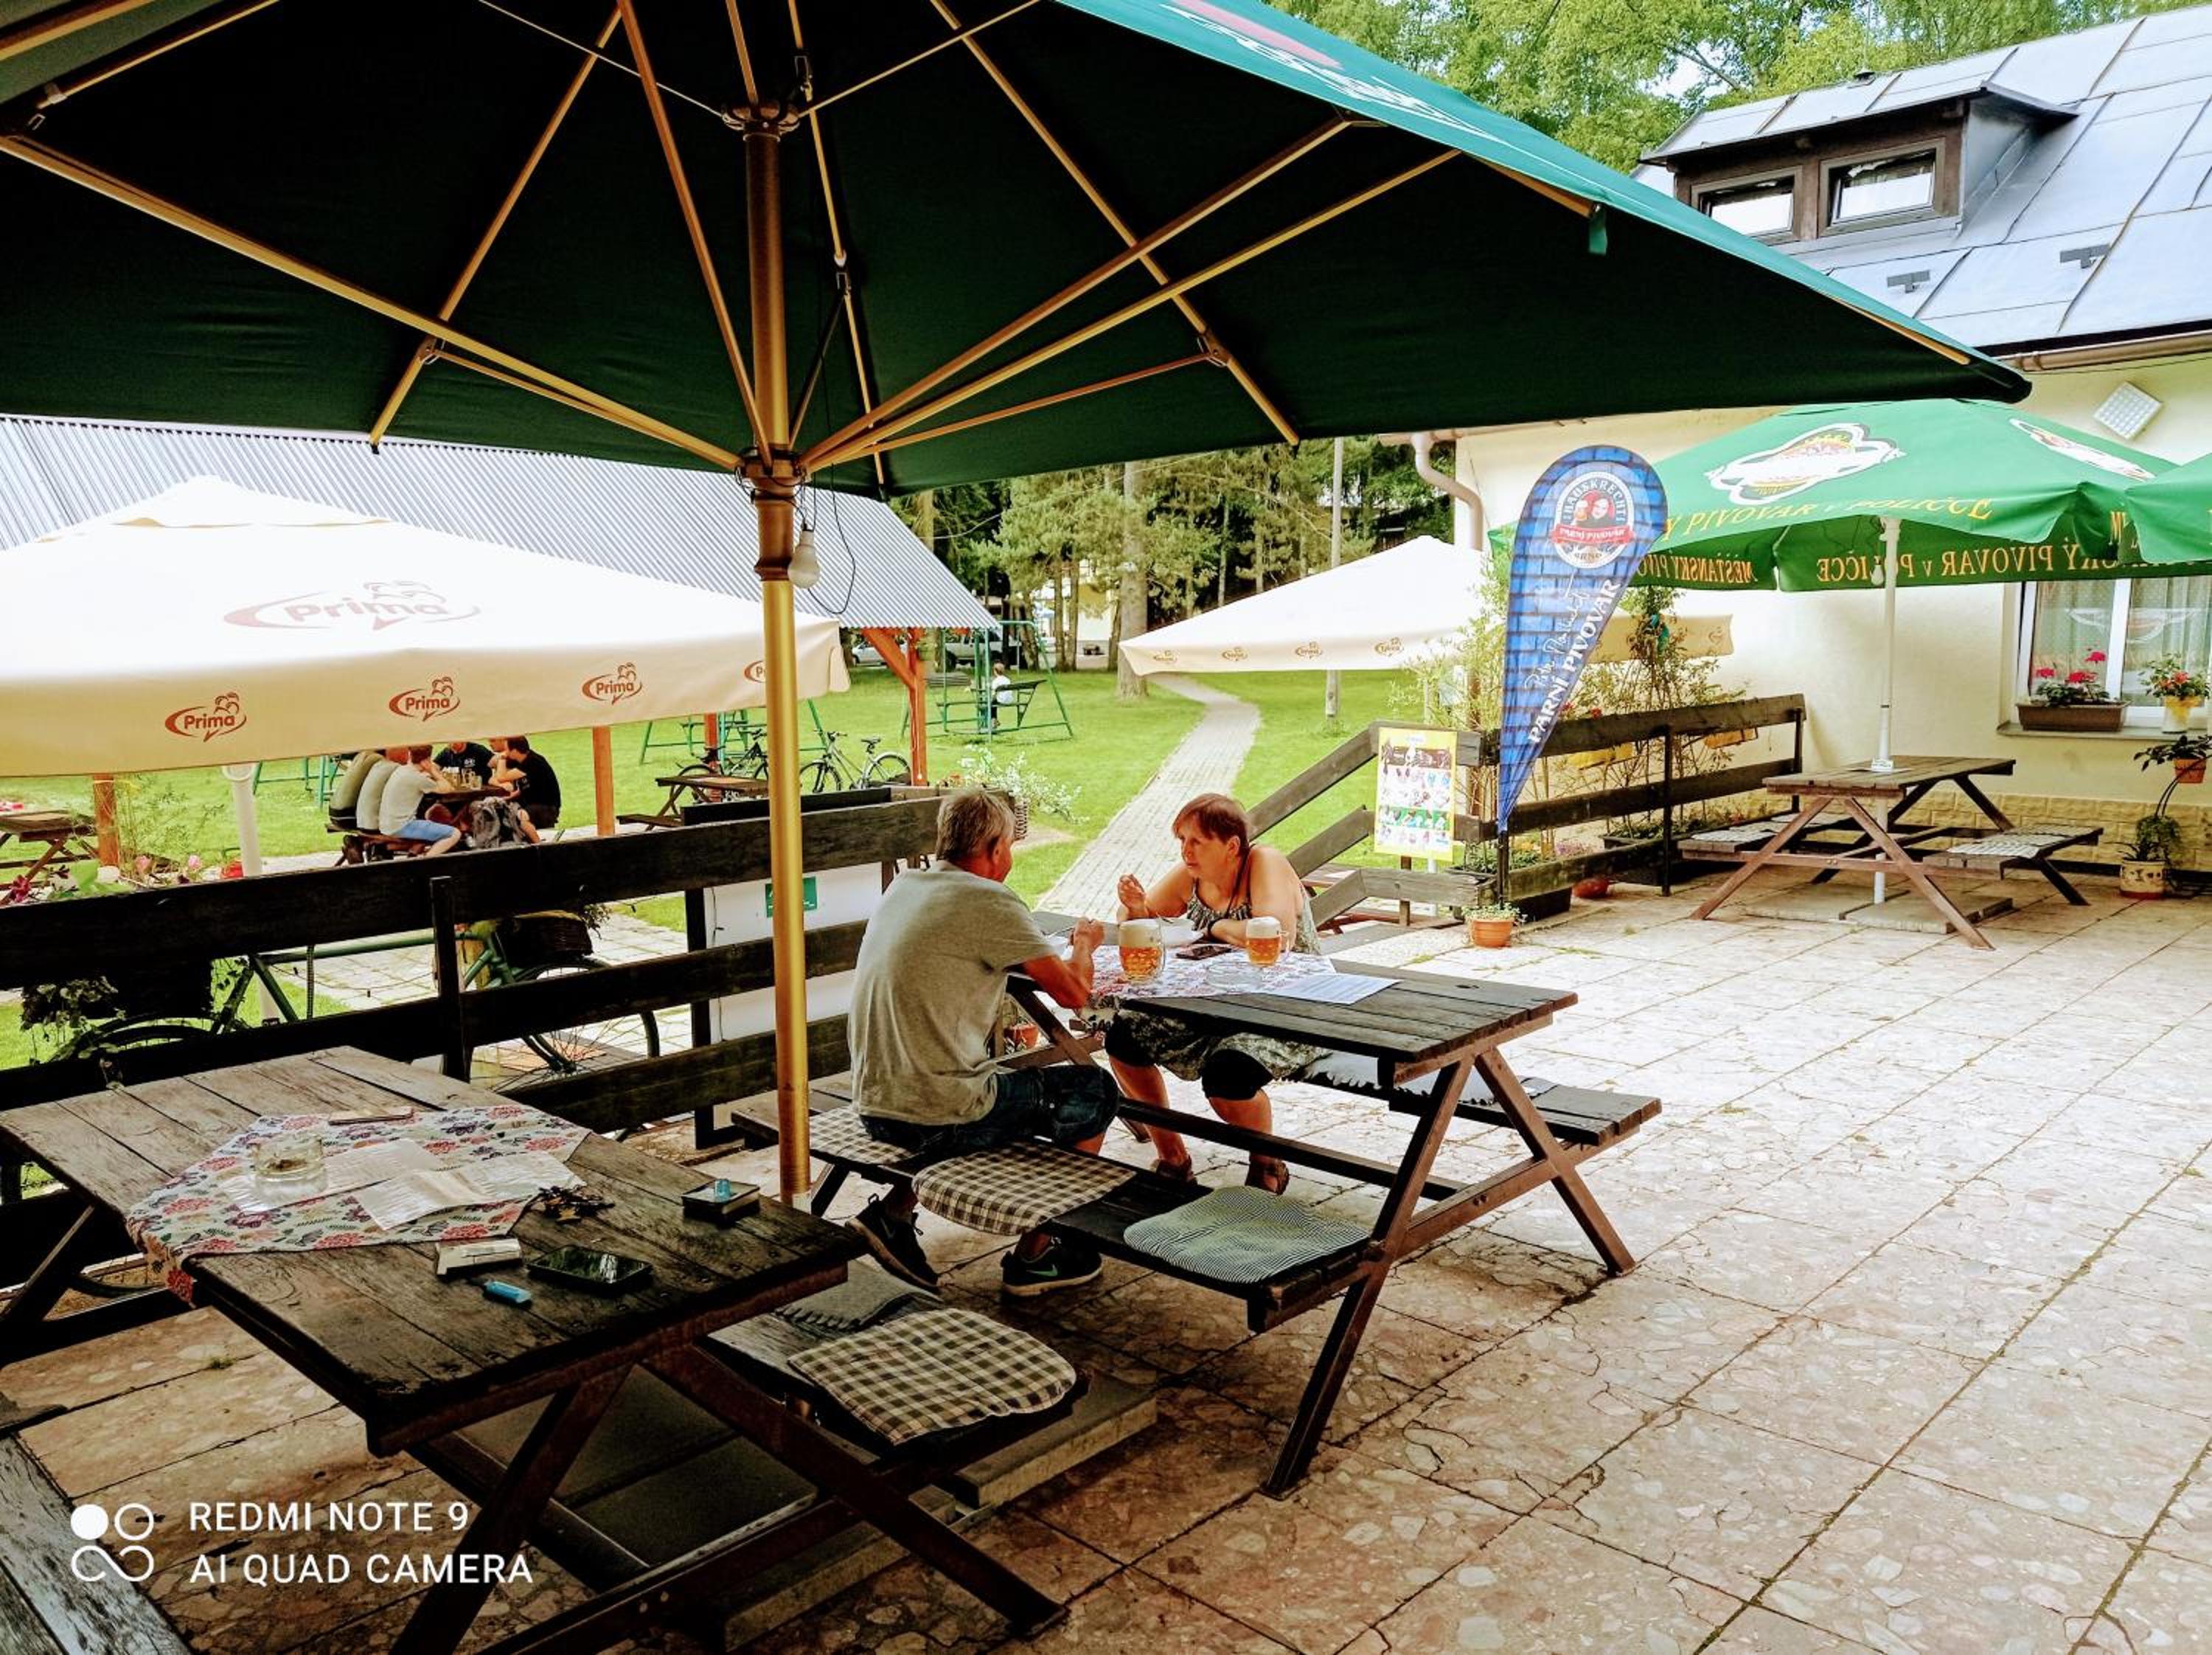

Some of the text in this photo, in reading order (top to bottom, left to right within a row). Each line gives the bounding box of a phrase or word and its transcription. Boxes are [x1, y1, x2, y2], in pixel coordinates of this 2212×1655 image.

[1683, 503, 1818, 536] PIVOVAR
[284, 597, 449, 622] Prima
[1528, 674, 1571, 743] PARNÍ
[1562, 579, 1621, 673] PIVOVAR
[596, 679, 634, 695] Prima
[406, 695, 450, 710] Prima
[184, 713, 235, 729] Prima
